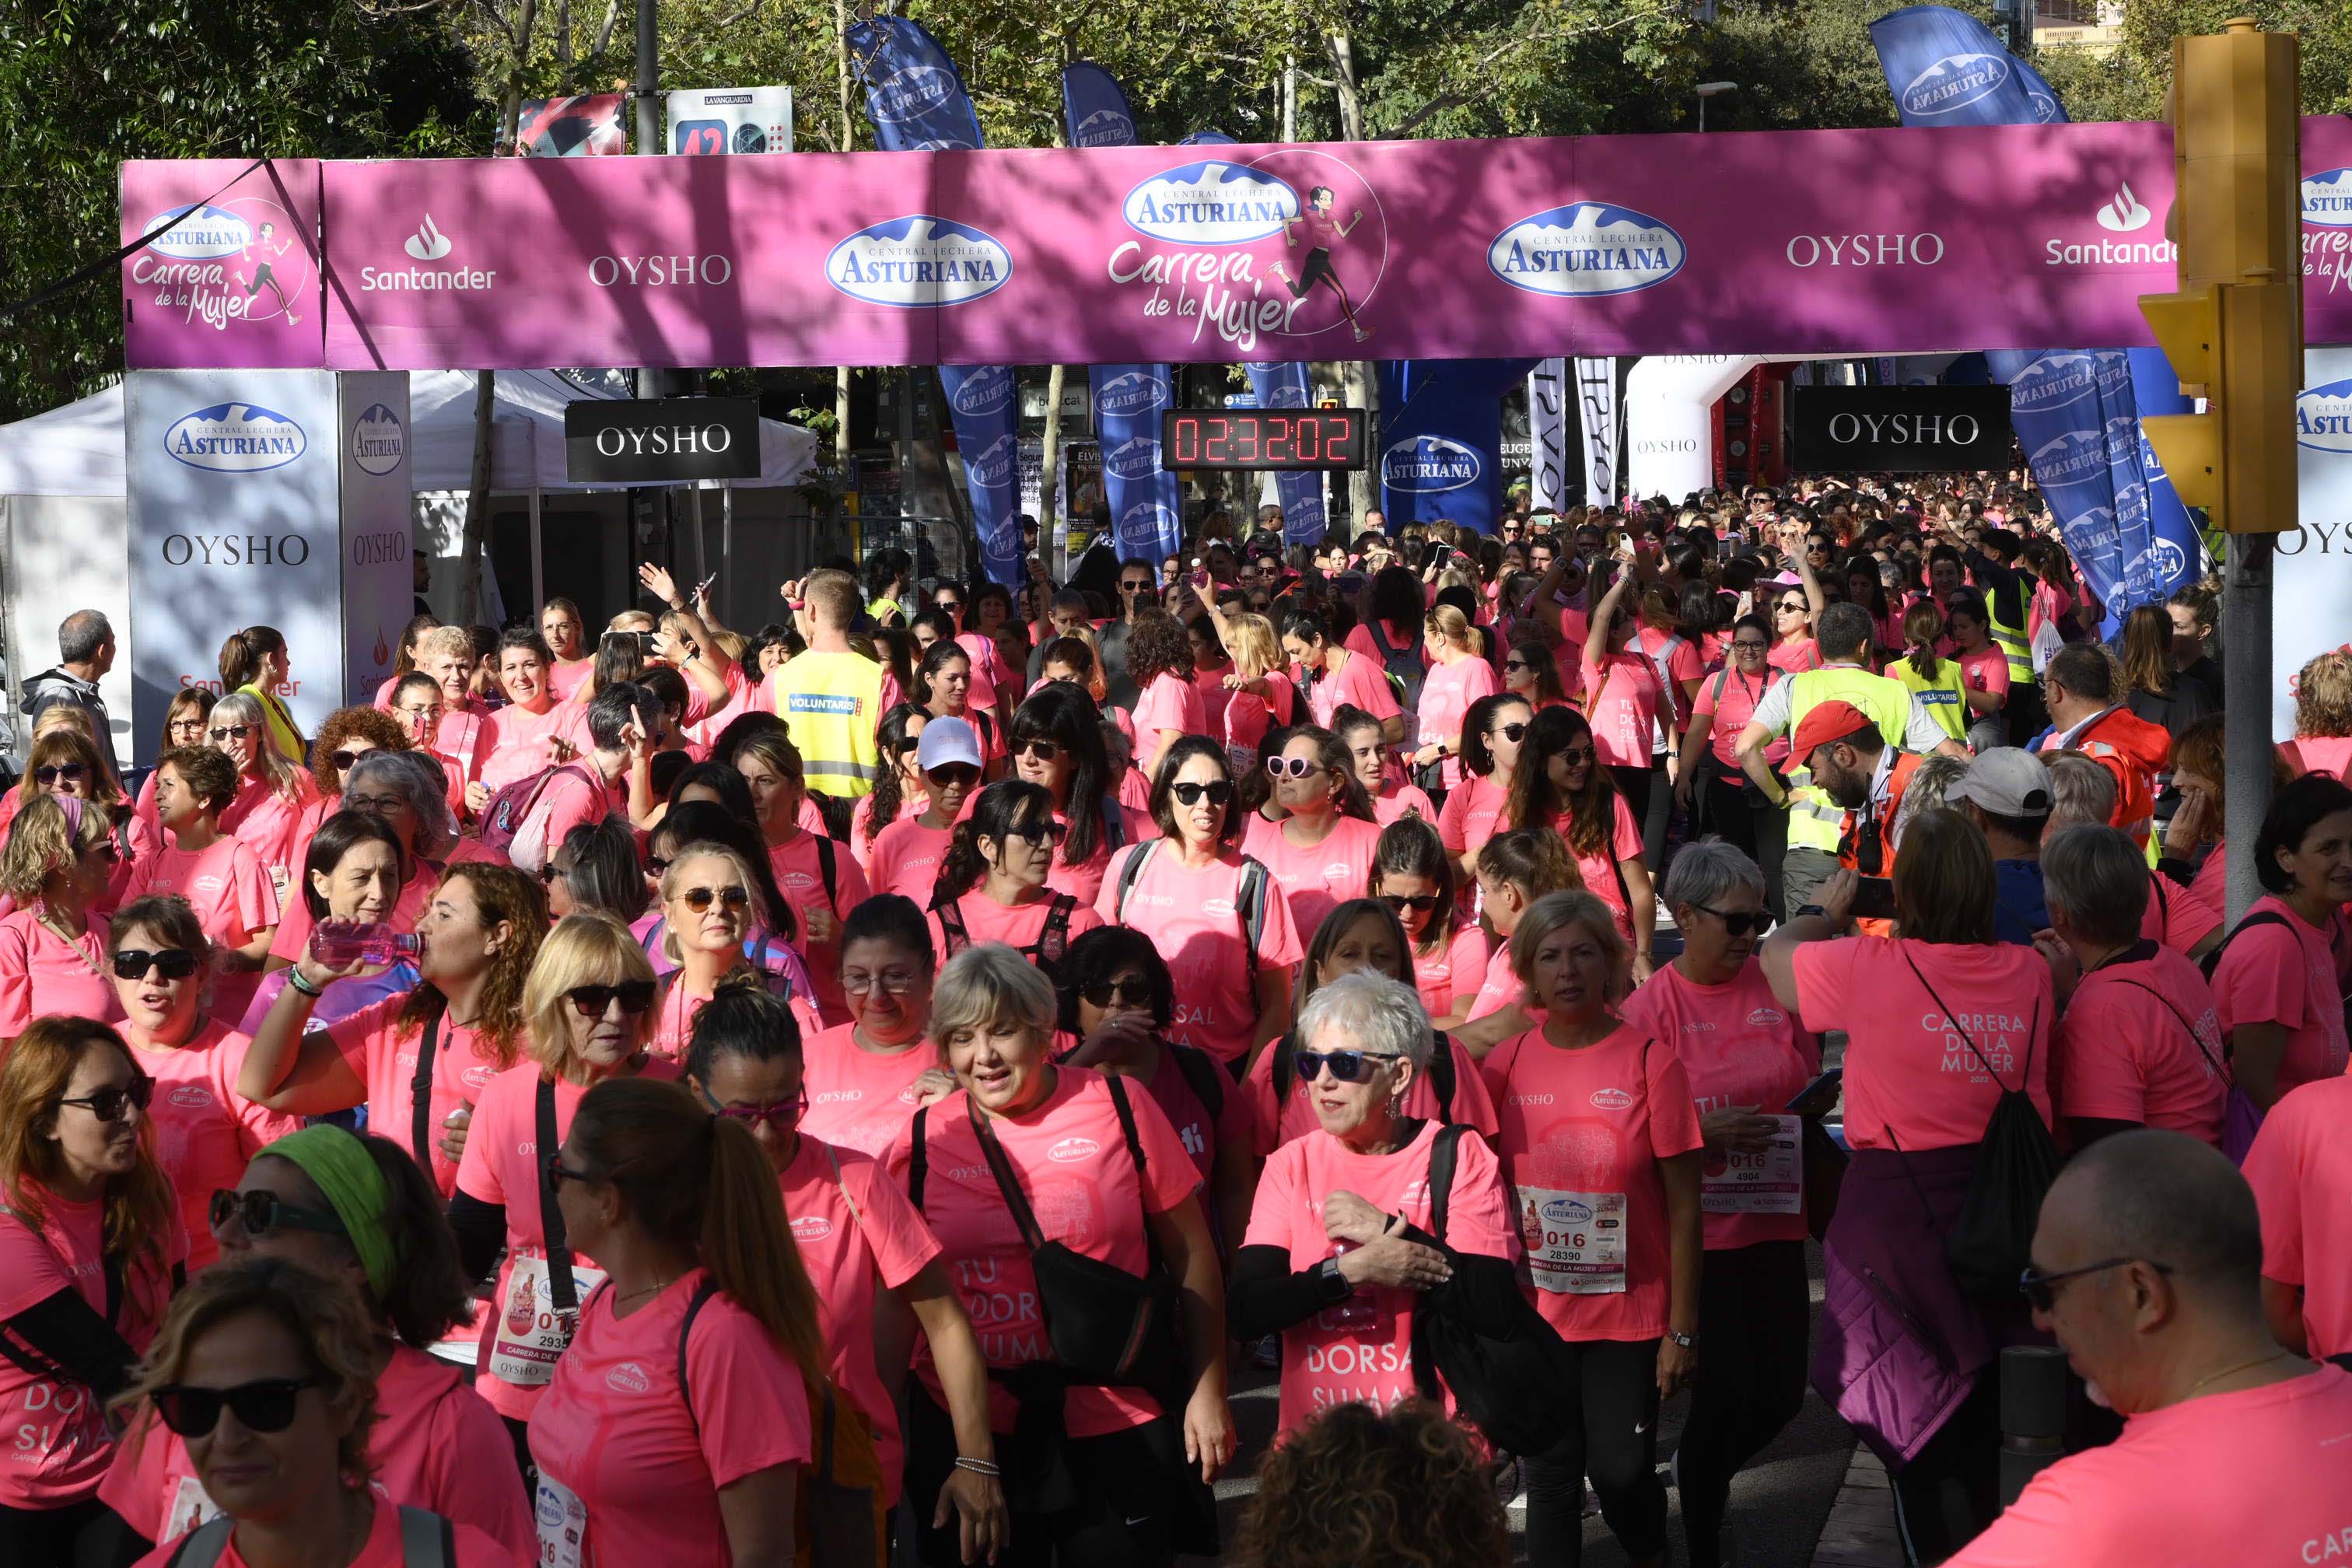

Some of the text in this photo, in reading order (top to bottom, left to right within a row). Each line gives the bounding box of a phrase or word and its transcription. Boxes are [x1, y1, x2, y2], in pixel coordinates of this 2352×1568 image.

[713, 95, 751, 104] VANGUARDIA
[1163, 187, 1283, 199] CENTRAL LECHERA
[1136, 192, 1284, 224] ASTURIANA
[1533, 233, 1664, 244] CENTRAL LECHERA
[869, 246, 992, 257] CENTRAL LECHERA
[1503, 238, 1671, 273] ASTURIANA
[1787, 233, 1944, 268] OYSHO
[2046, 237, 2177, 264] Santande
[133, 256, 223, 285] Carrera
[589, 254, 731, 286] OYSHO
[840, 250, 997, 284] ASTURIANA
[1108, 240, 1253, 284] Carrera
[362, 267, 497, 291] Santander
[156, 283, 258, 331] de la Mujer
[1143, 278, 1307, 352] de la Mujer
[1829, 413, 1979, 445] OYSHO
[175, 429, 296, 456] ASTURIANA
[356, 432, 401, 457] ASTURIANA
[597, 424, 731, 457] OYSHO
[1176, 418, 1349, 460] 02:32:02
[1637, 439, 1696, 455] OYSHO
[1019, 451, 1043, 463] Segur
[1384, 460, 1472, 481] ASTURIANA
[162, 534, 309, 566] OYSHO
[353, 531, 404, 566] OYSHO
[790, 697, 854, 711] VOLUNTARIS
[904, 856, 935, 871] OYSHO
[1922, 1013, 2027, 1033] CARRERA
[1946, 1034, 2010, 1052] DE LA
[395, 1052, 417, 1068] OYS
[1941, 1053, 2014, 1072] MUJER
[817, 1090, 862, 1104] OYSHO
[1509, 1093, 1554, 1107] OYSHO
[1593, 1095, 1631, 1107] ASTURIANA
[1054, 1145, 1097, 1160] ASTURIANA
[1731, 1154, 1766, 1169] 016
[948, 1164, 990, 1181] OYSH
[1545, 1207, 1588, 1220] ASTURIANA
[789, 1224, 830, 1238] STURIANA
[1547, 1231, 1586, 1248] 016
[1550, 1250, 1580, 1261] 28390
[955, 1257, 996, 1285] TU
[1530, 1261, 1552, 1269] ARRERA
[971, 1291, 1038, 1321] DOR
[507, 1346, 539, 1358] CARRERA
[500, 1363, 538, 1376] OYSHO
